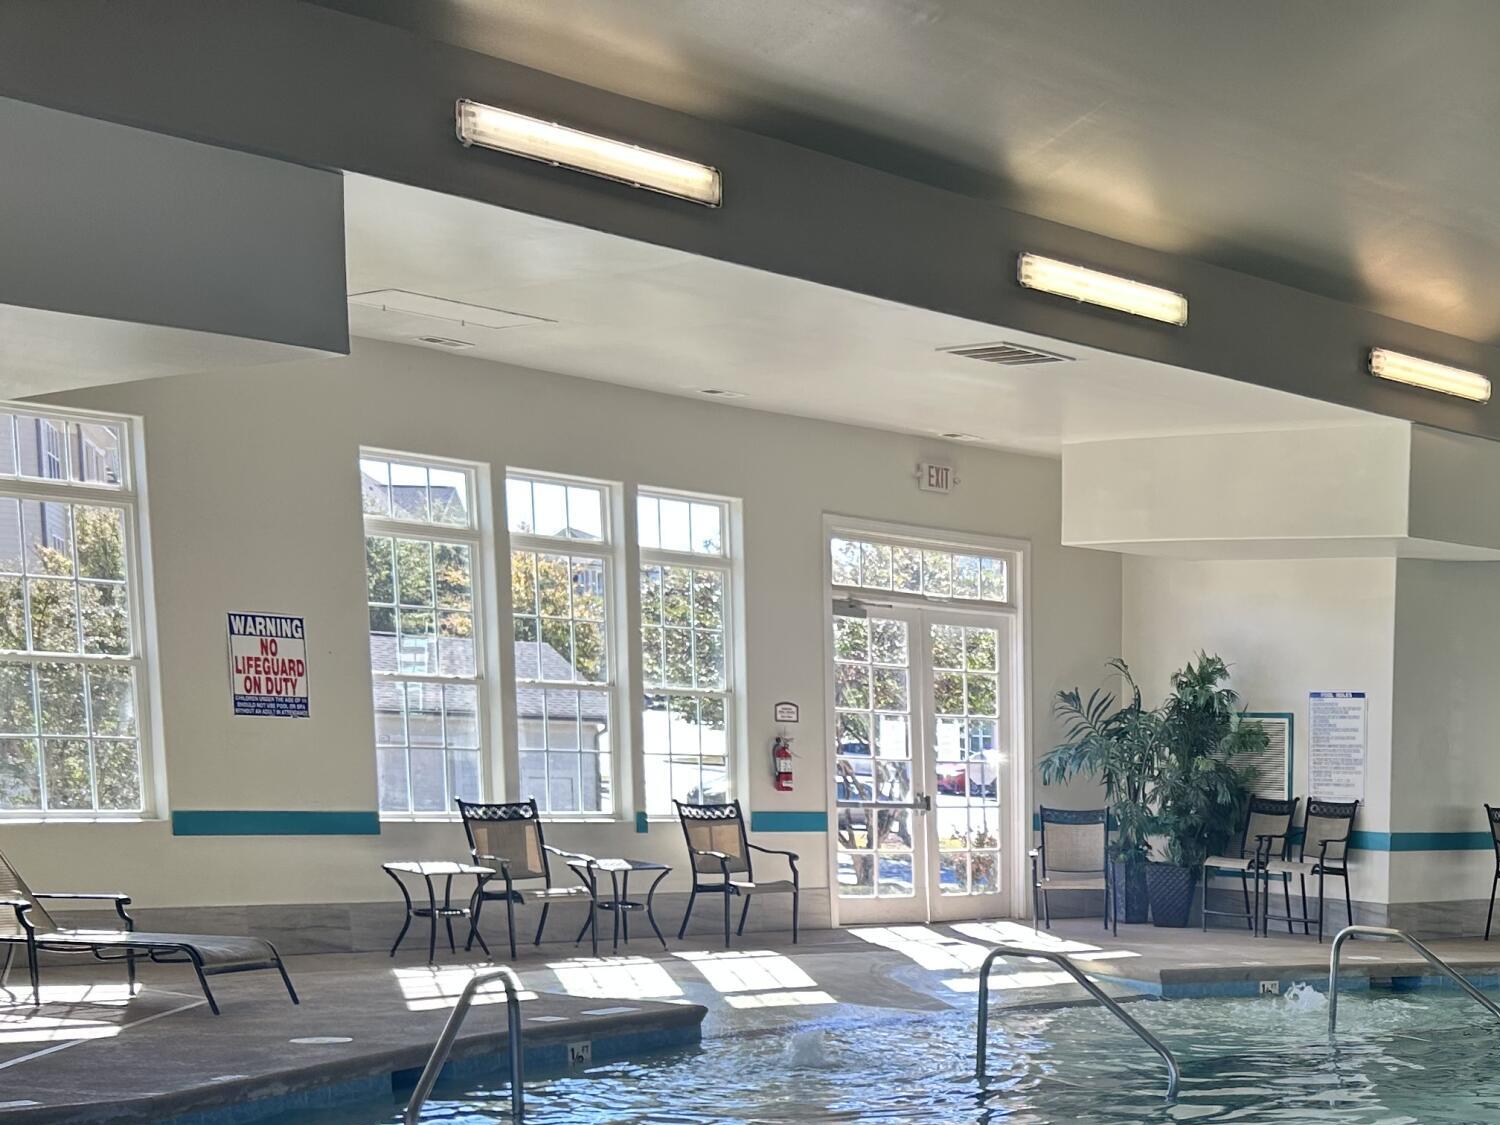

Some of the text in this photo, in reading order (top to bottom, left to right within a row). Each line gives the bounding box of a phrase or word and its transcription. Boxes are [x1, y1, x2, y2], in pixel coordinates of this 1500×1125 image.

[928, 464, 950, 490] EXIT
[230, 615, 303, 638] WARNING
[260, 638, 278, 657] NO
[234, 656, 305, 677] LIFEGUARD
[244, 676, 297, 696] ON DUTY
